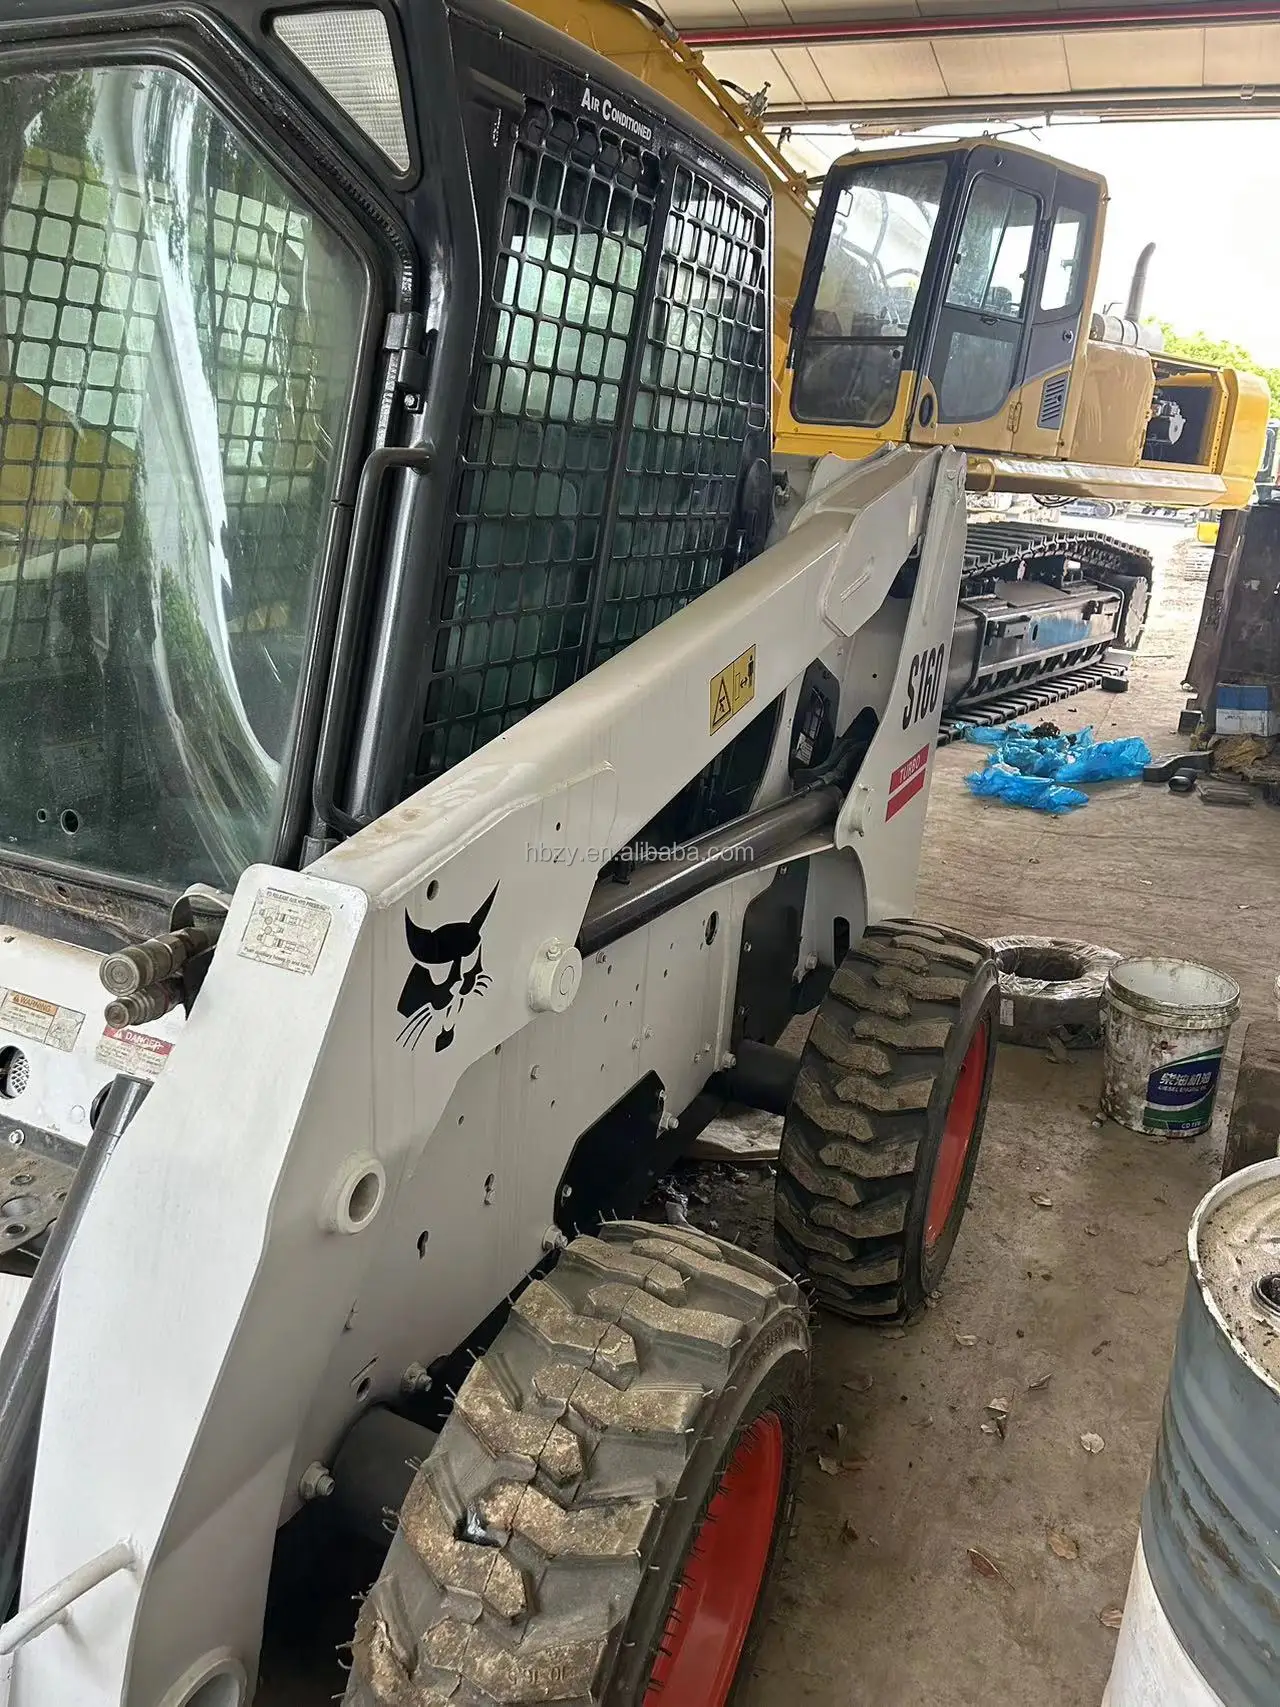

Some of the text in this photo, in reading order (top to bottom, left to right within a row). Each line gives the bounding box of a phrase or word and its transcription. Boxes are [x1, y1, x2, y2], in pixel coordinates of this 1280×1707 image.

[602, 98, 652, 141] CONDITIONED
[902, 642, 945, 730] S160
[899, 753, 921, 782] TURBO
[20, 996, 52, 1013] WARNING
[125, 1031, 162, 1048] DANGER
[1160, 1072, 1212, 1086] 柴油机油
